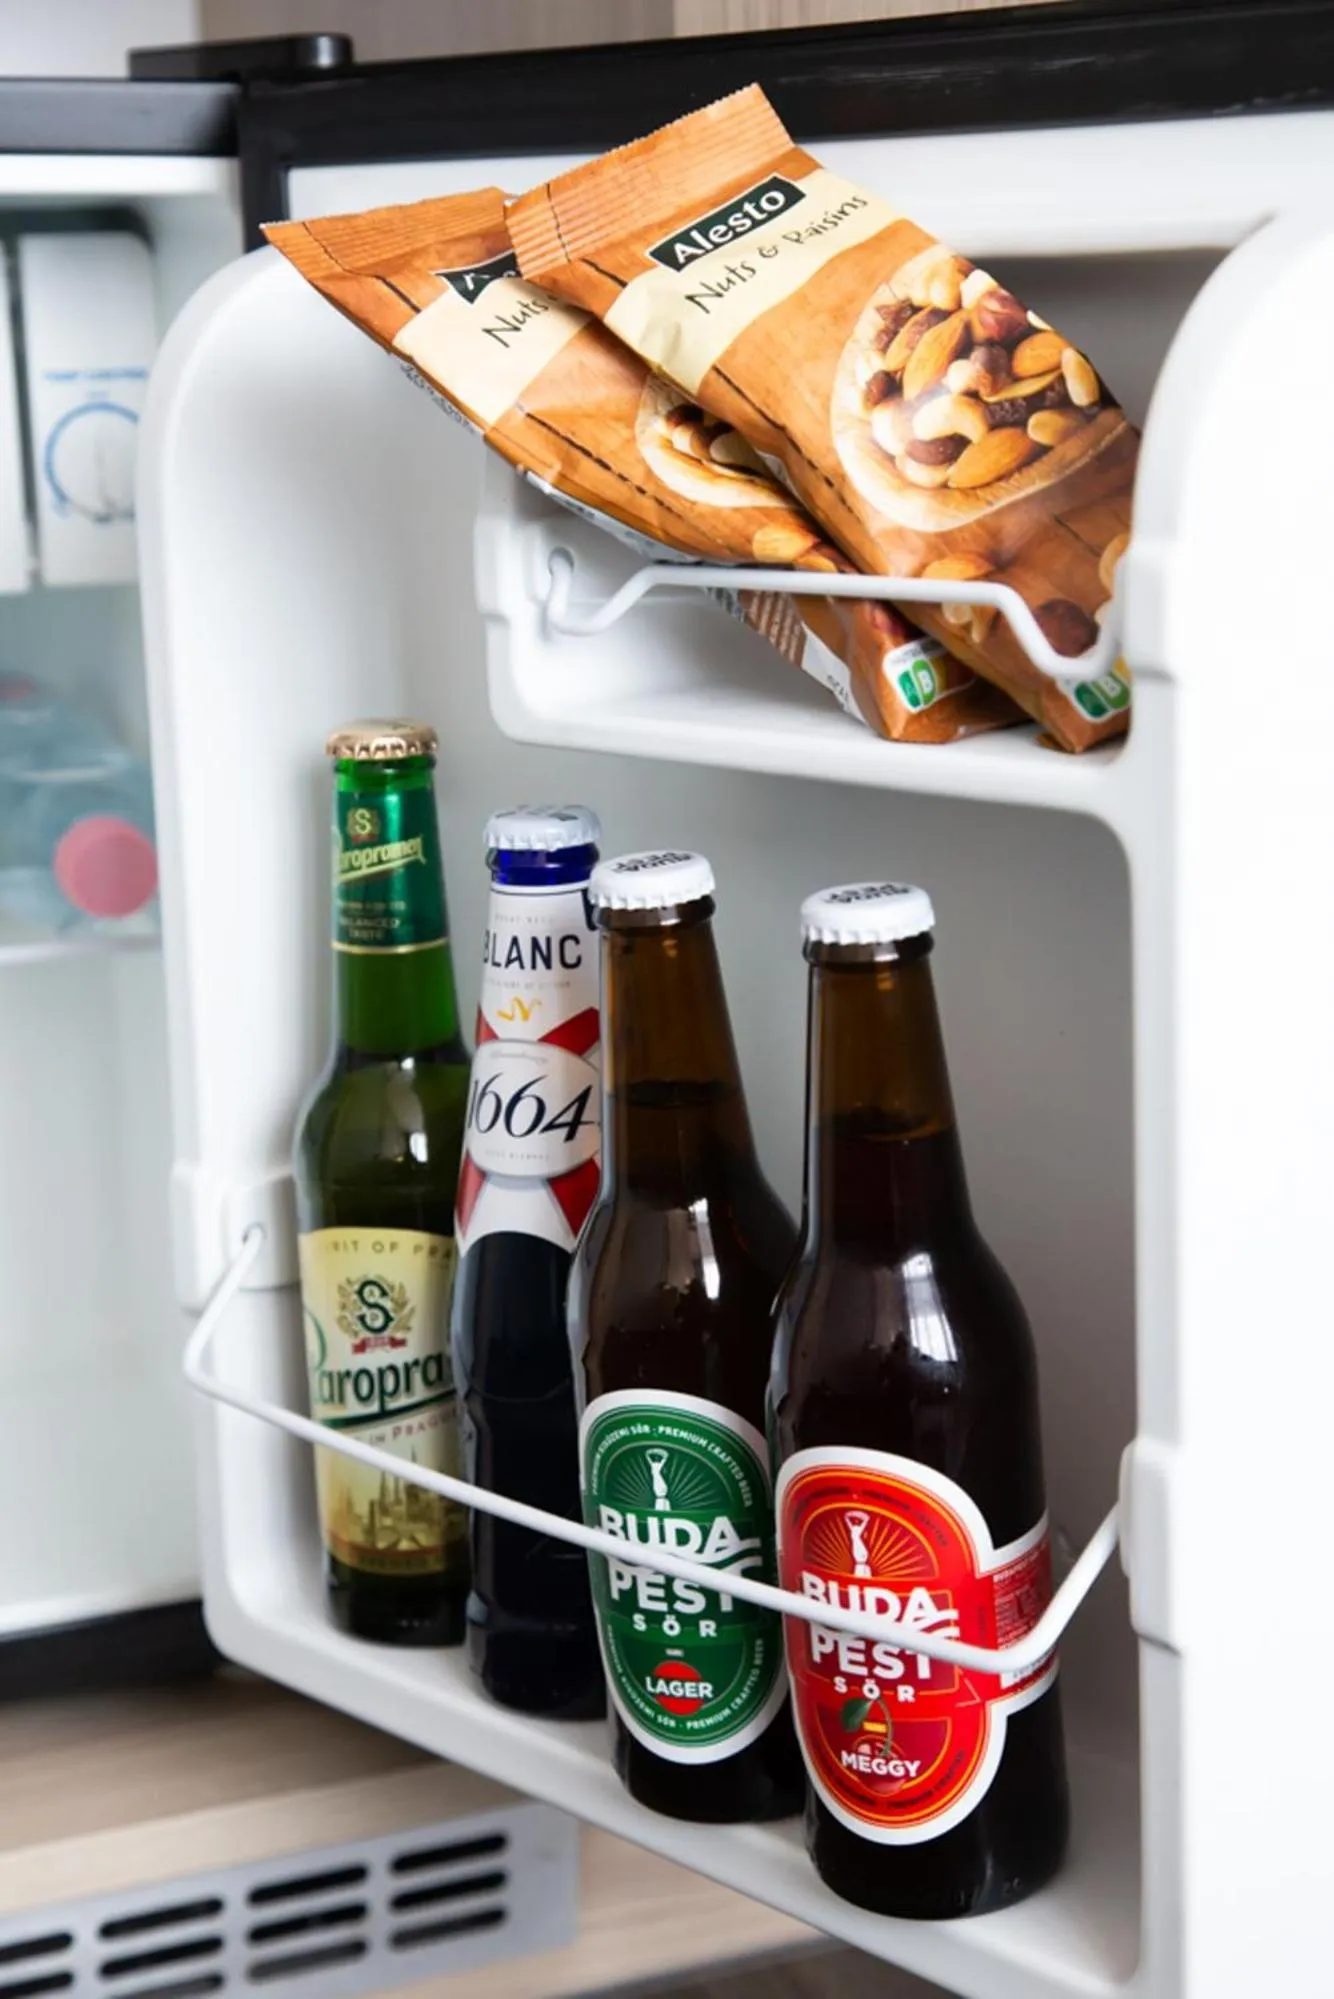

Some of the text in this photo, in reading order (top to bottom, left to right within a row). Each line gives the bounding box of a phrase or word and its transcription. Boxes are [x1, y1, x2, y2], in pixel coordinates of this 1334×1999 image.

[673, 190, 786, 264] Alesto
[684, 260, 756, 315] Nuts
[781, 195, 869, 245] Raisins
[481, 300, 549, 348] Nuts
[355, 808, 372, 834] S
[467, 1072, 594, 1143] 1664
[371, 1240, 399, 1253] OF
[355, 1280, 395, 1334] S
[314, 1350, 446, 1412] aropra
[658, 1425, 708, 1448] PREMIUM
[707, 1443, 745, 1480] CRAFTED
[600, 1504, 761, 1563] BUDA
[608, 1556, 750, 1614] PEST
[802, 1571, 958, 1630] BUDA
[632, 1613, 717, 1638] SÖR
[810, 1622, 942, 1679] PEST
[645, 1676, 713, 1698] LAGER
[833, 1676, 916, 1702] SÖR
[841, 1751, 921, 1778] MEGGY
